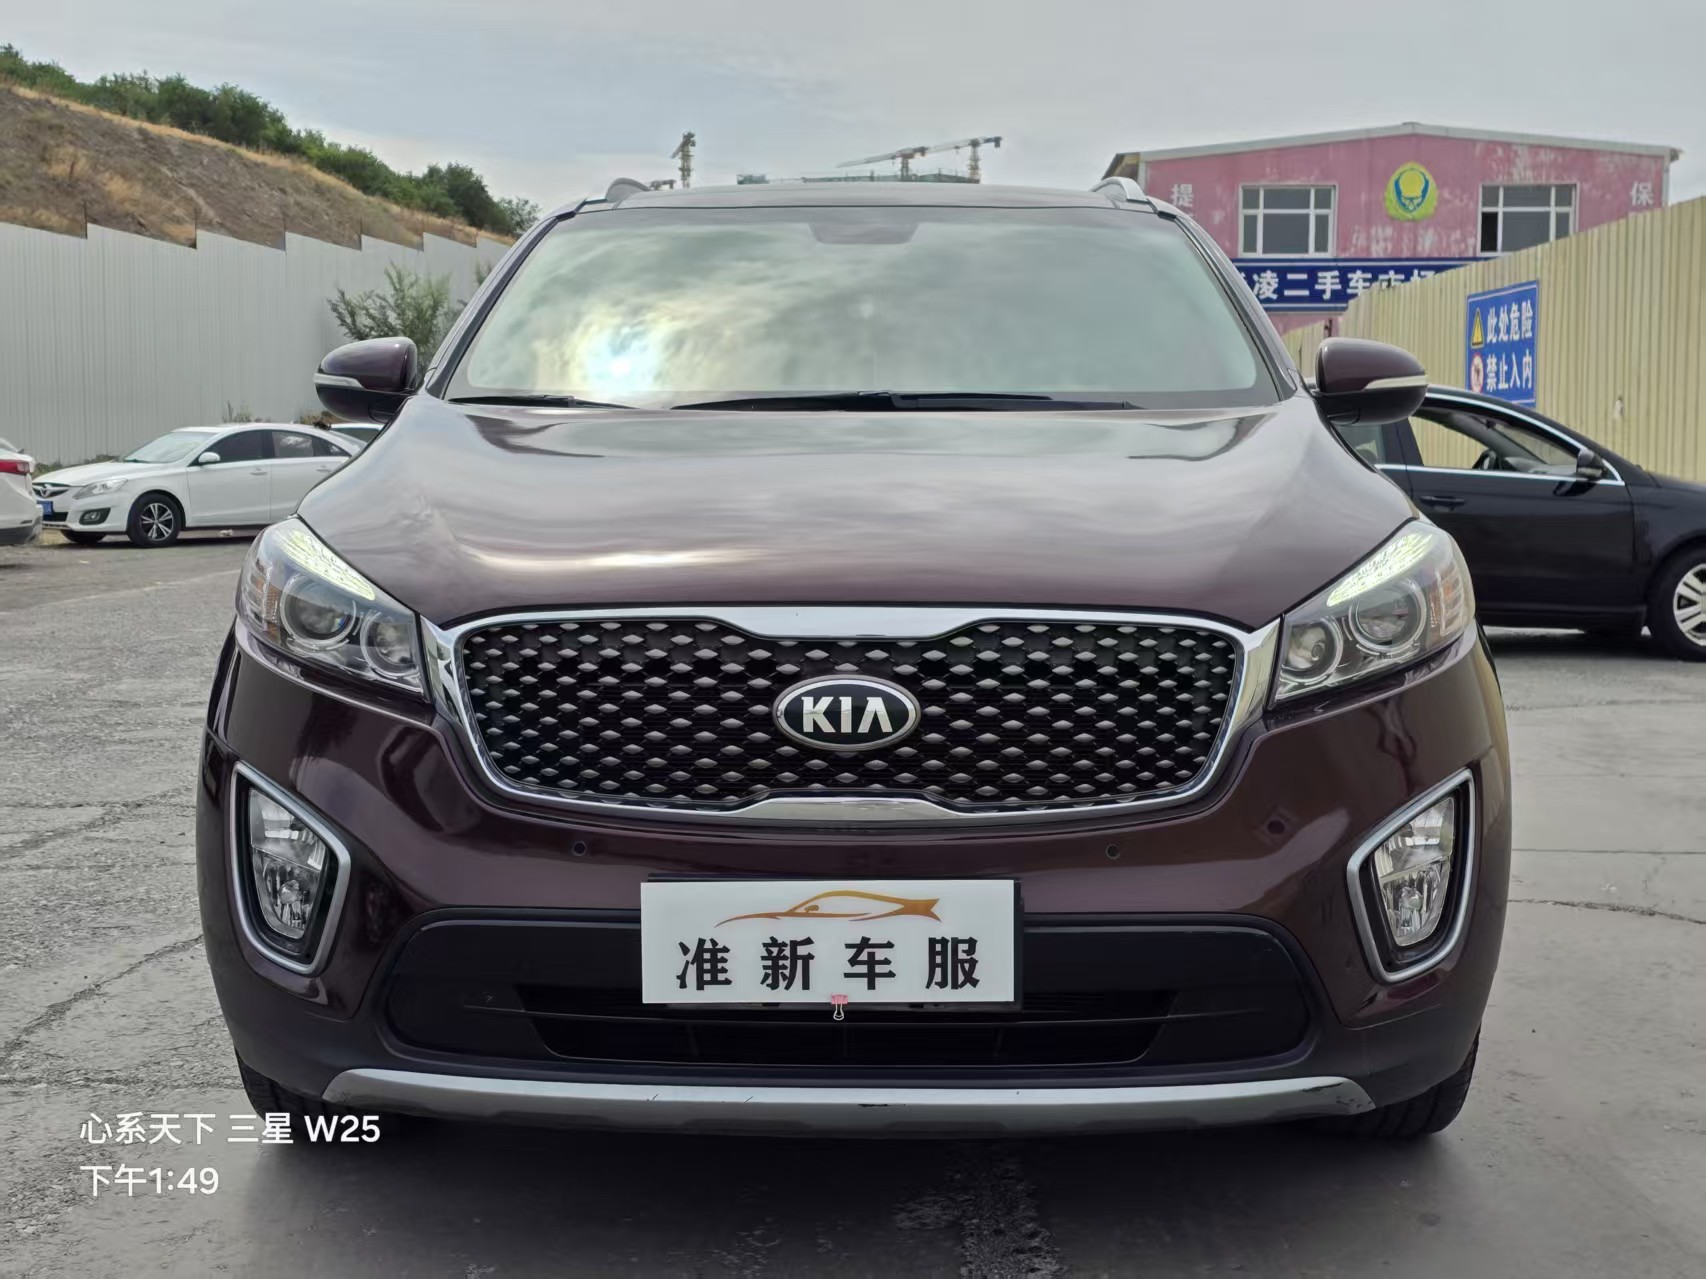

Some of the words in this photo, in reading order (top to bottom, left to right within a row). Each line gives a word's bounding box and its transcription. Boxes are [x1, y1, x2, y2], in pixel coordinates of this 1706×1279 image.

[1170, 183, 1193, 207] 提
[1630, 181, 1653, 206] 保
[1486, 299, 1533, 344] 此处危险
[1486, 348, 1533, 392] 禁止入内
[801, 696, 893, 733] KIA
[676, 936, 980, 991] 准新车服
